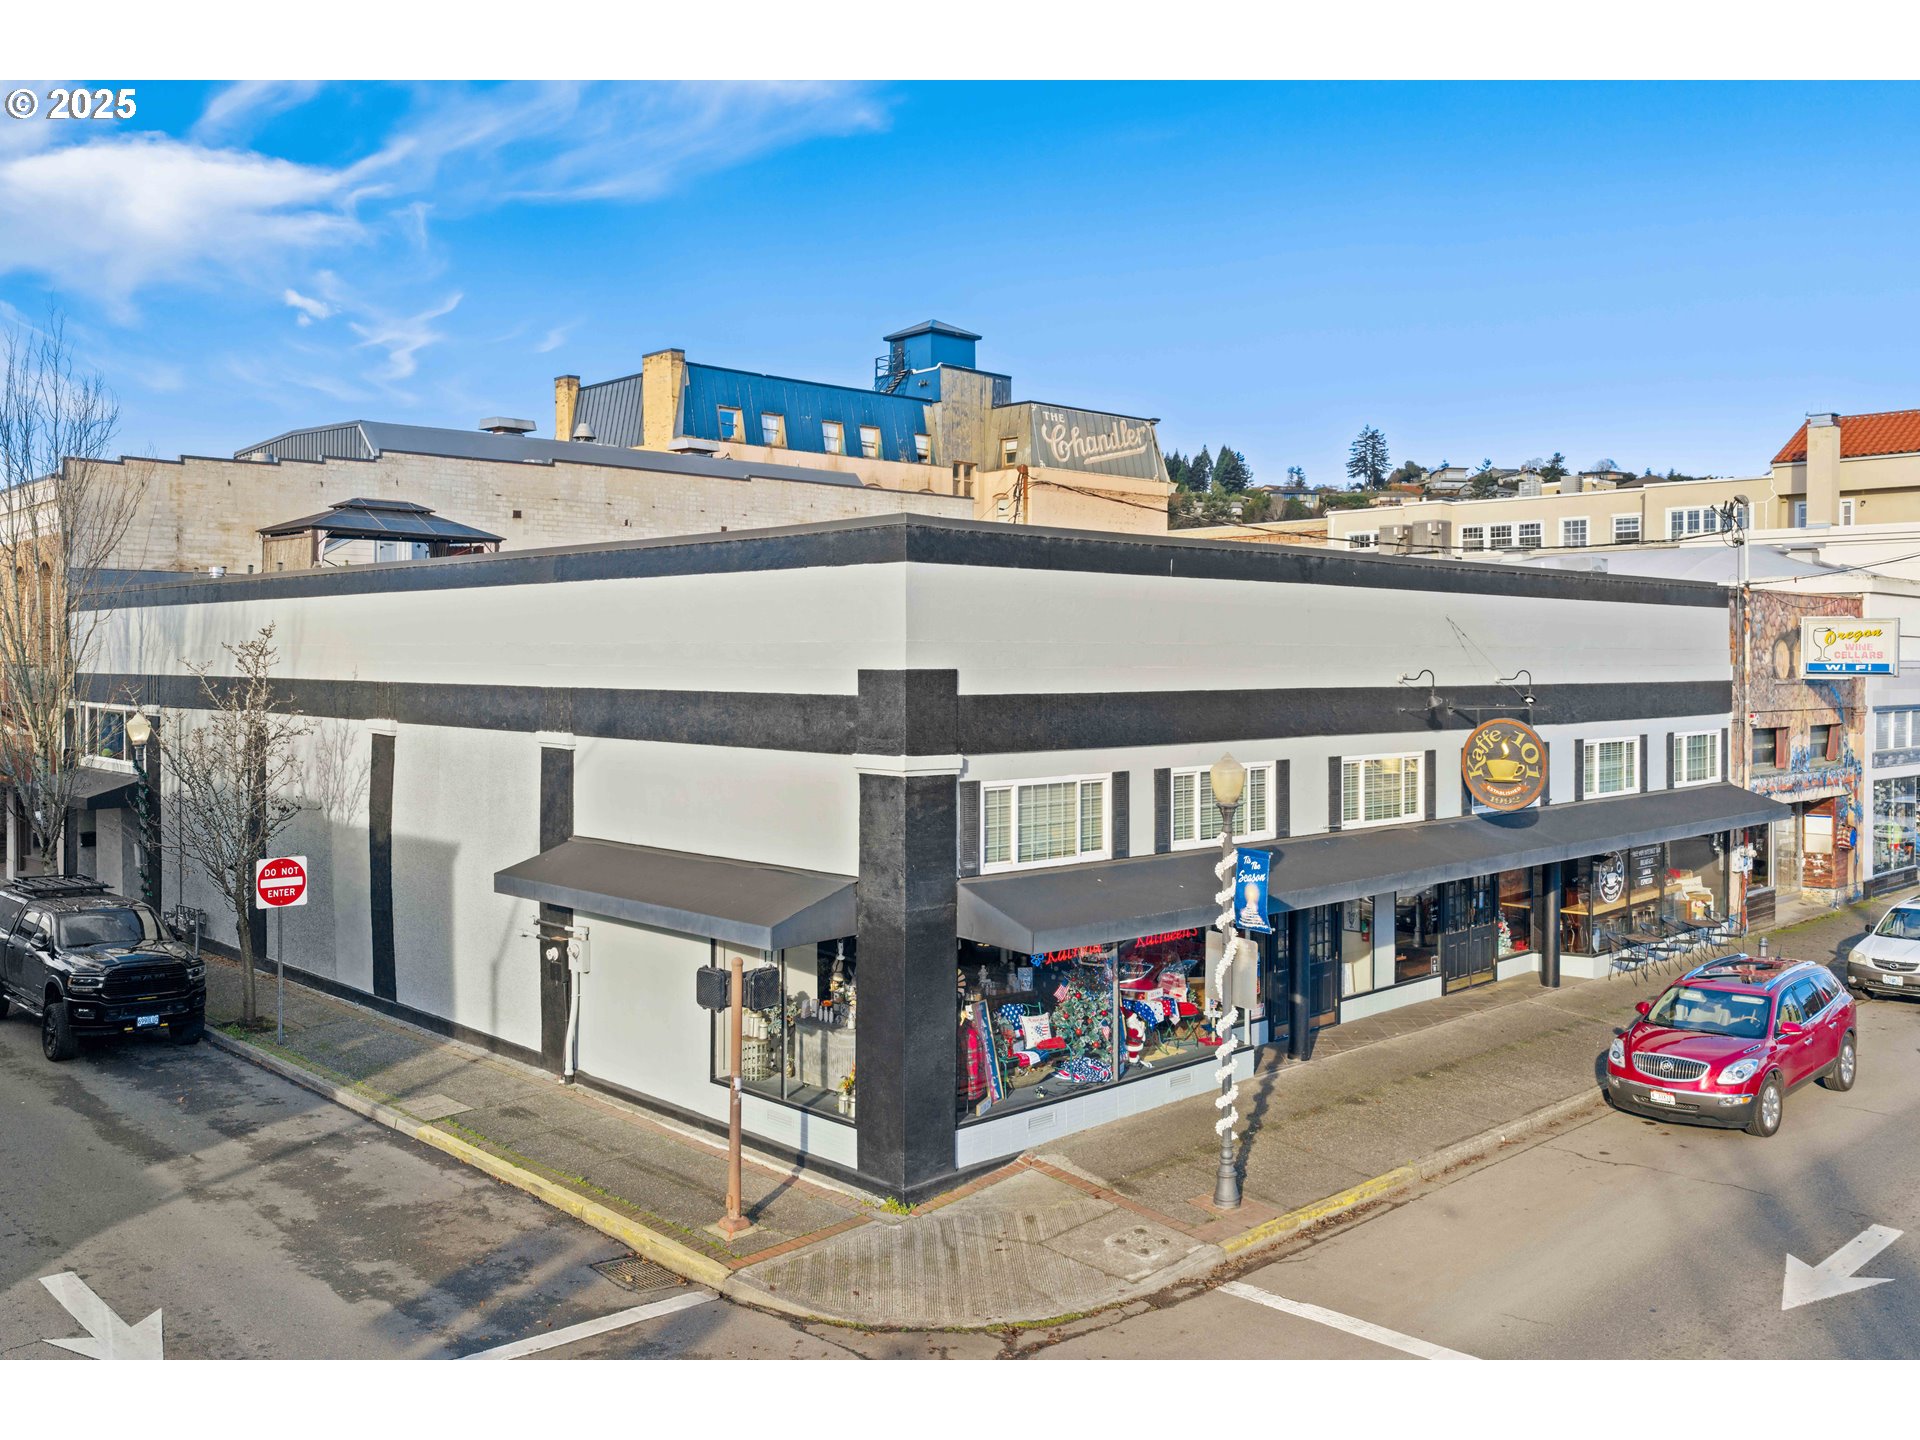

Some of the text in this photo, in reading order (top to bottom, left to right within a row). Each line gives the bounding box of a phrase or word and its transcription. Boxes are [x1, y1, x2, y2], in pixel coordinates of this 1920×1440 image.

[1042, 411, 1065, 423] THE
[1041, 419, 1147, 463] Chandler
[1824, 629, 1883, 646] Oregon
[1844, 643, 1873, 651] WINE
[1834, 651, 1884, 659] CELLARS
[1467, 729, 1540, 780] Kaffe 101
[1486, 785, 1521, 796] ESTABLISHED
[1489, 796, 1521, 804] 1992
[1250, 861, 1261, 870] The
[264, 866, 299, 877] DO NOT
[1238, 869, 1266, 883] Season
[267, 887, 296, 898] ENTER
